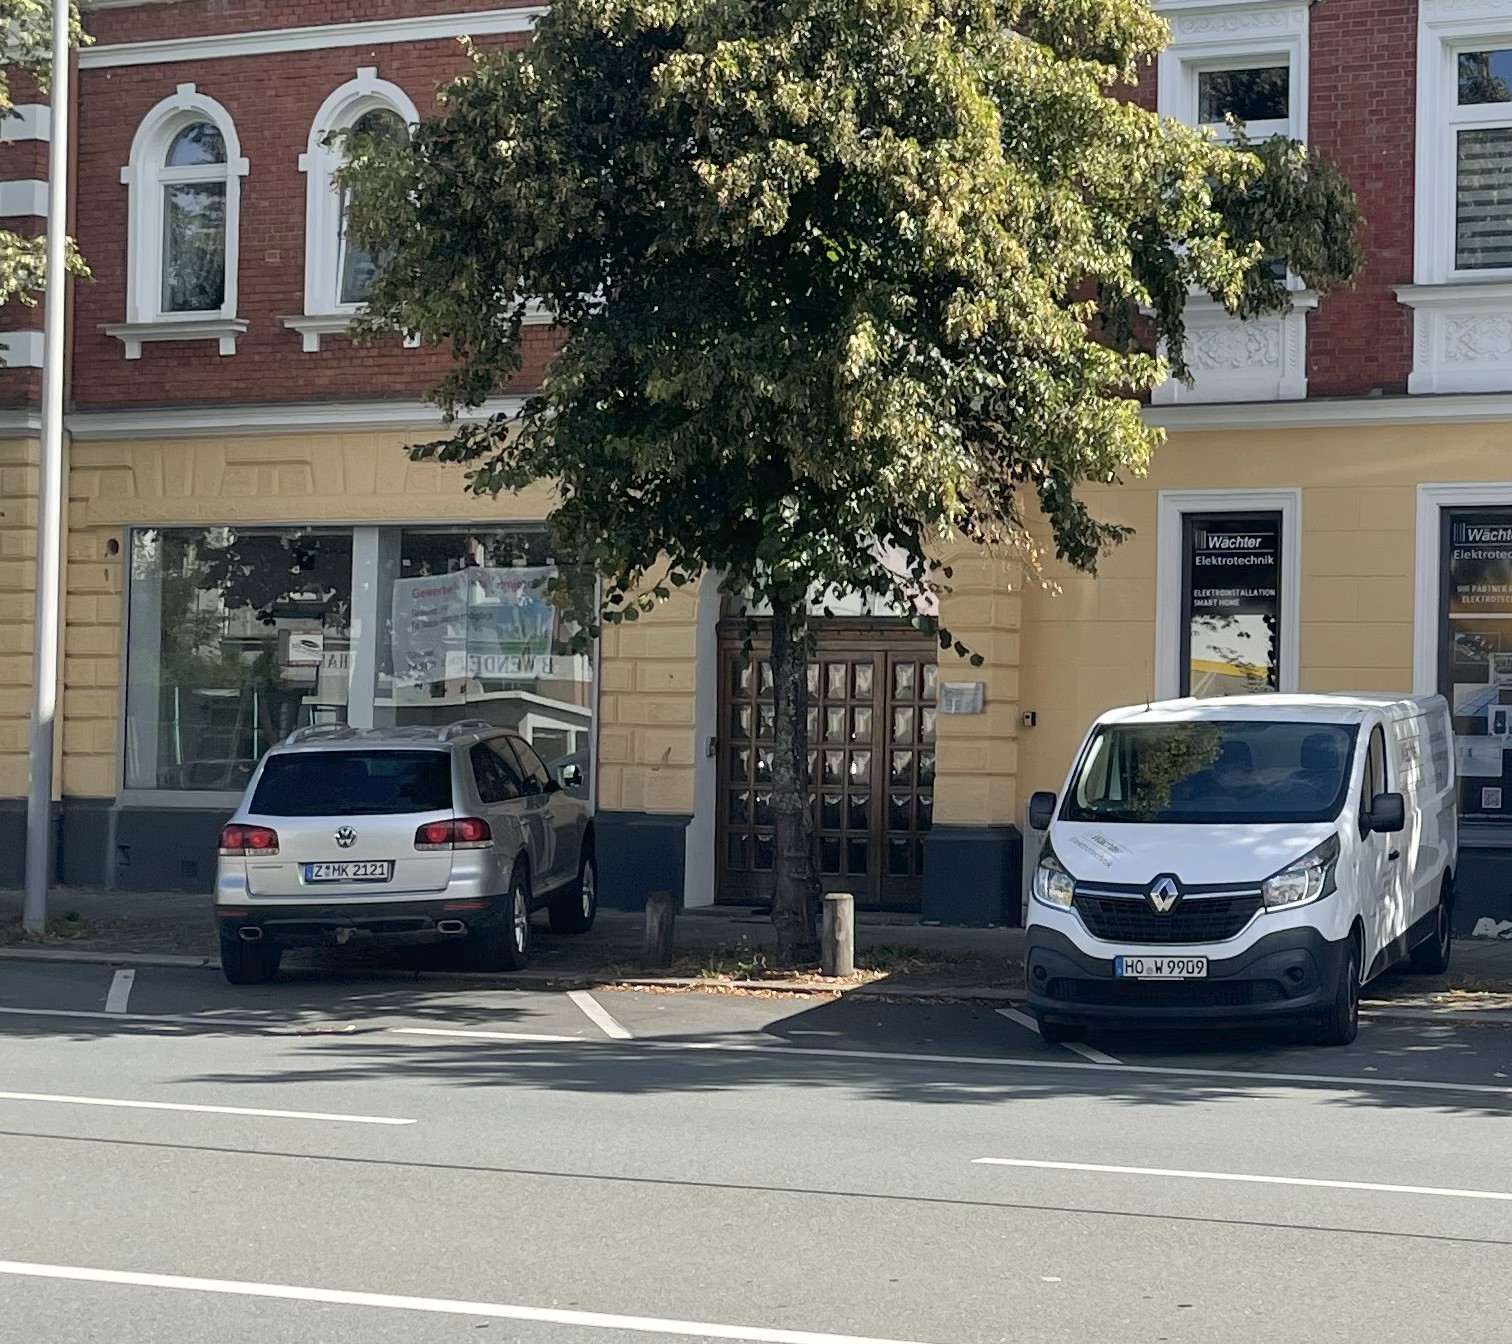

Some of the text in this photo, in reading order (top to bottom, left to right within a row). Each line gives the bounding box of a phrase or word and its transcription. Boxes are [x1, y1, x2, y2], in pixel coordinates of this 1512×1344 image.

[1208, 536, 1262, 548] Wächter
[1195, 555, 1274, 566] Elektrotechnik
[352, 863, 386, 876] 2121
[1125, 959, 1144, 975] HO
[1167, 959, 1204, 975] 9909
